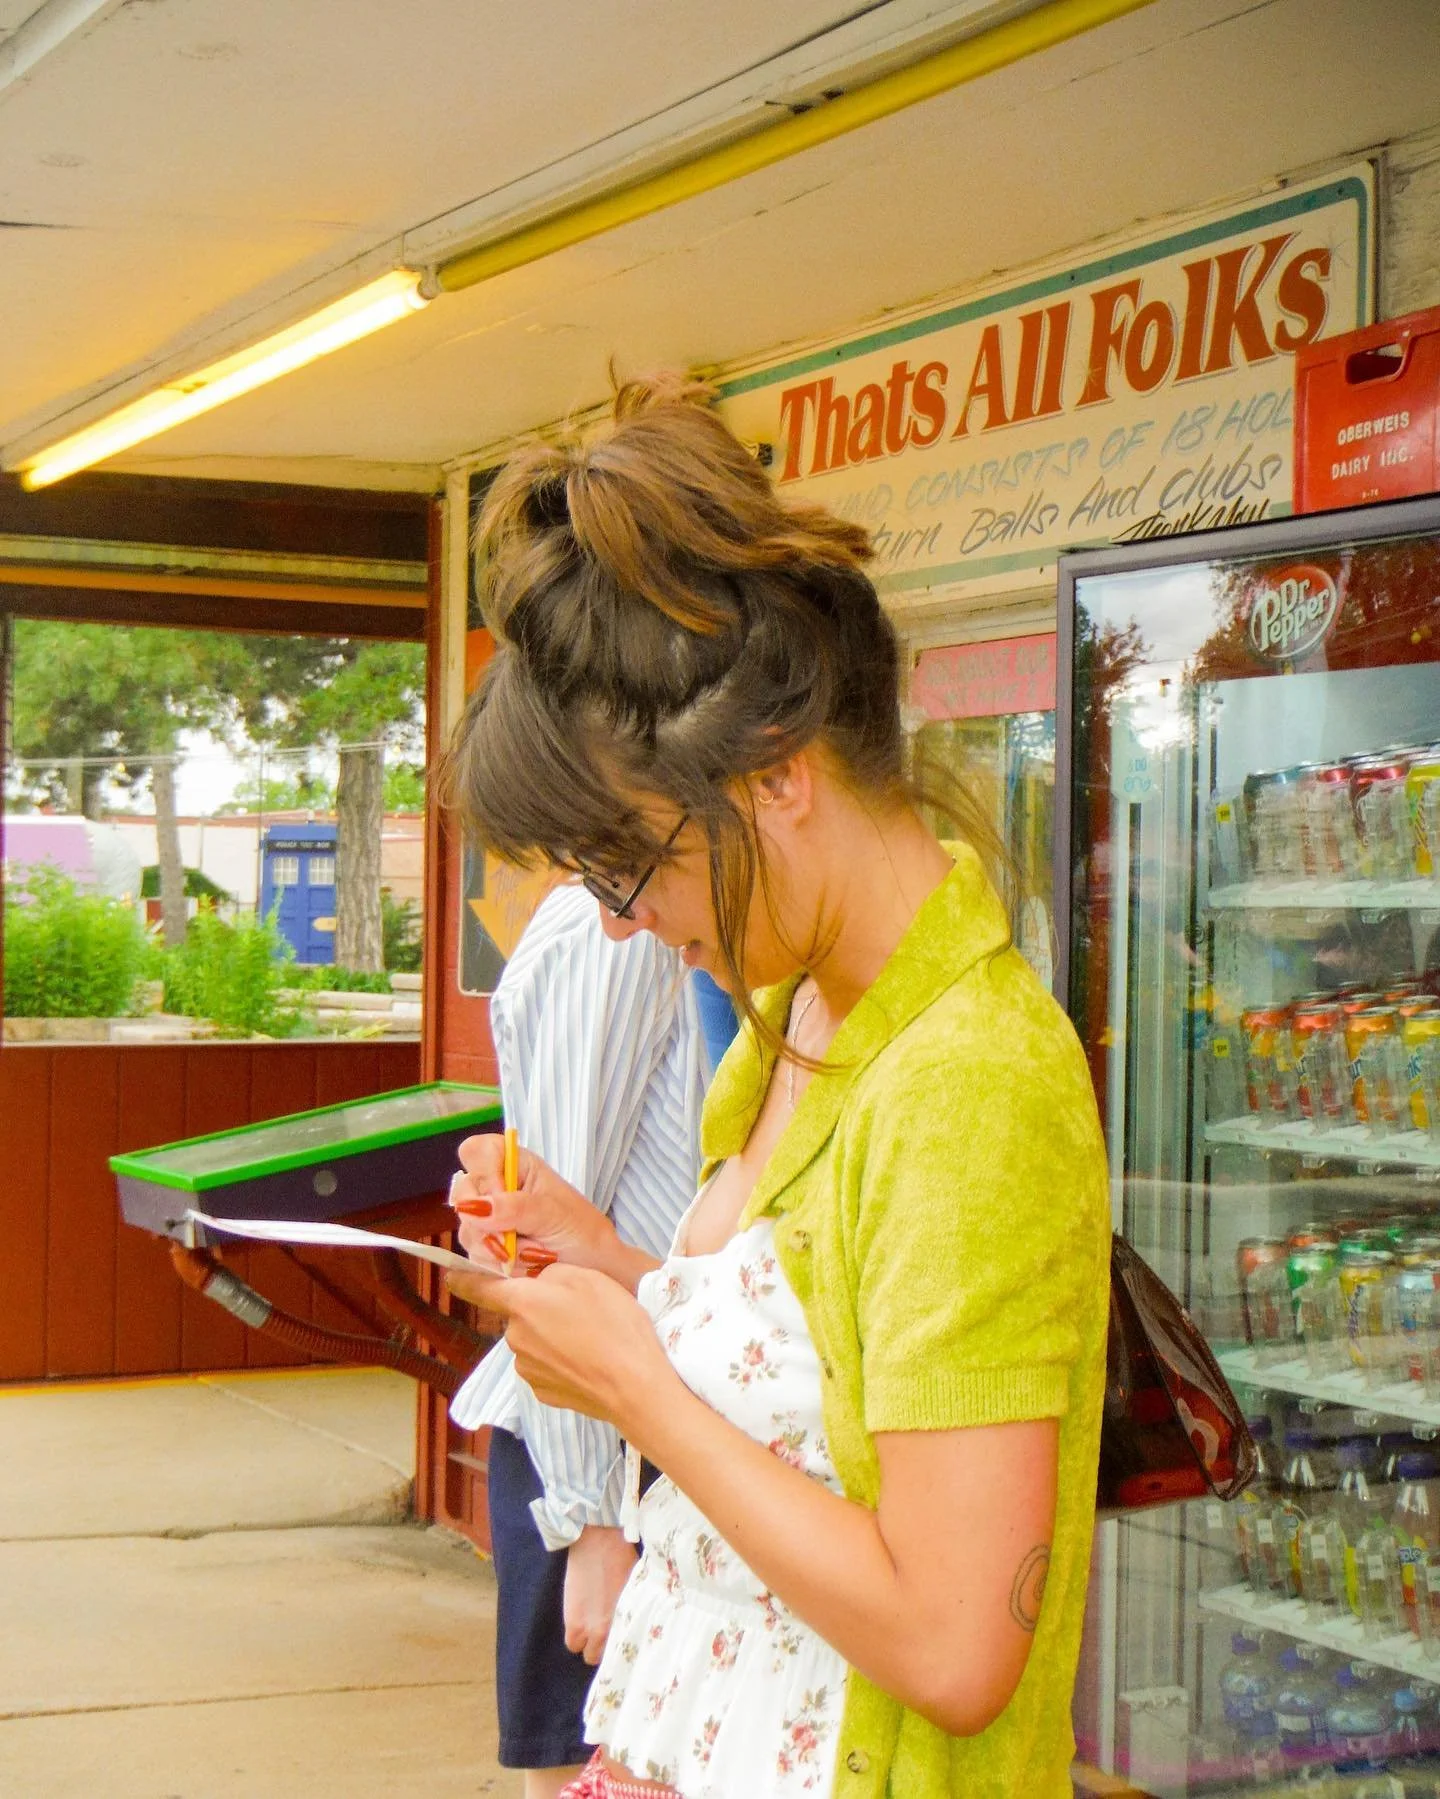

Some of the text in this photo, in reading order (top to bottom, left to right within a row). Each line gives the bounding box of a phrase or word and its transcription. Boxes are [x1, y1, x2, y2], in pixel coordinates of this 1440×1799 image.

[779, 359, 949, 484] Thats
[950, 301, 1072, 441] All
[906, 437, 1090, 513] CONSISTS
[1101, 420, 1155, 473] OF
[1161, 402, 1218, 457] 18
[1216, 387, 1292, 441] HOL
[1337, 411, 1410, 446] OBERWEIS
[1331, 455, 1370, 481] DAIRY
[960, 487, 1059, 555] Balls
[1068, 465, 1157, 530] And
[1251, 588, 1330, 652] Pepper
[1280, 578, 1311, 616] Dr
